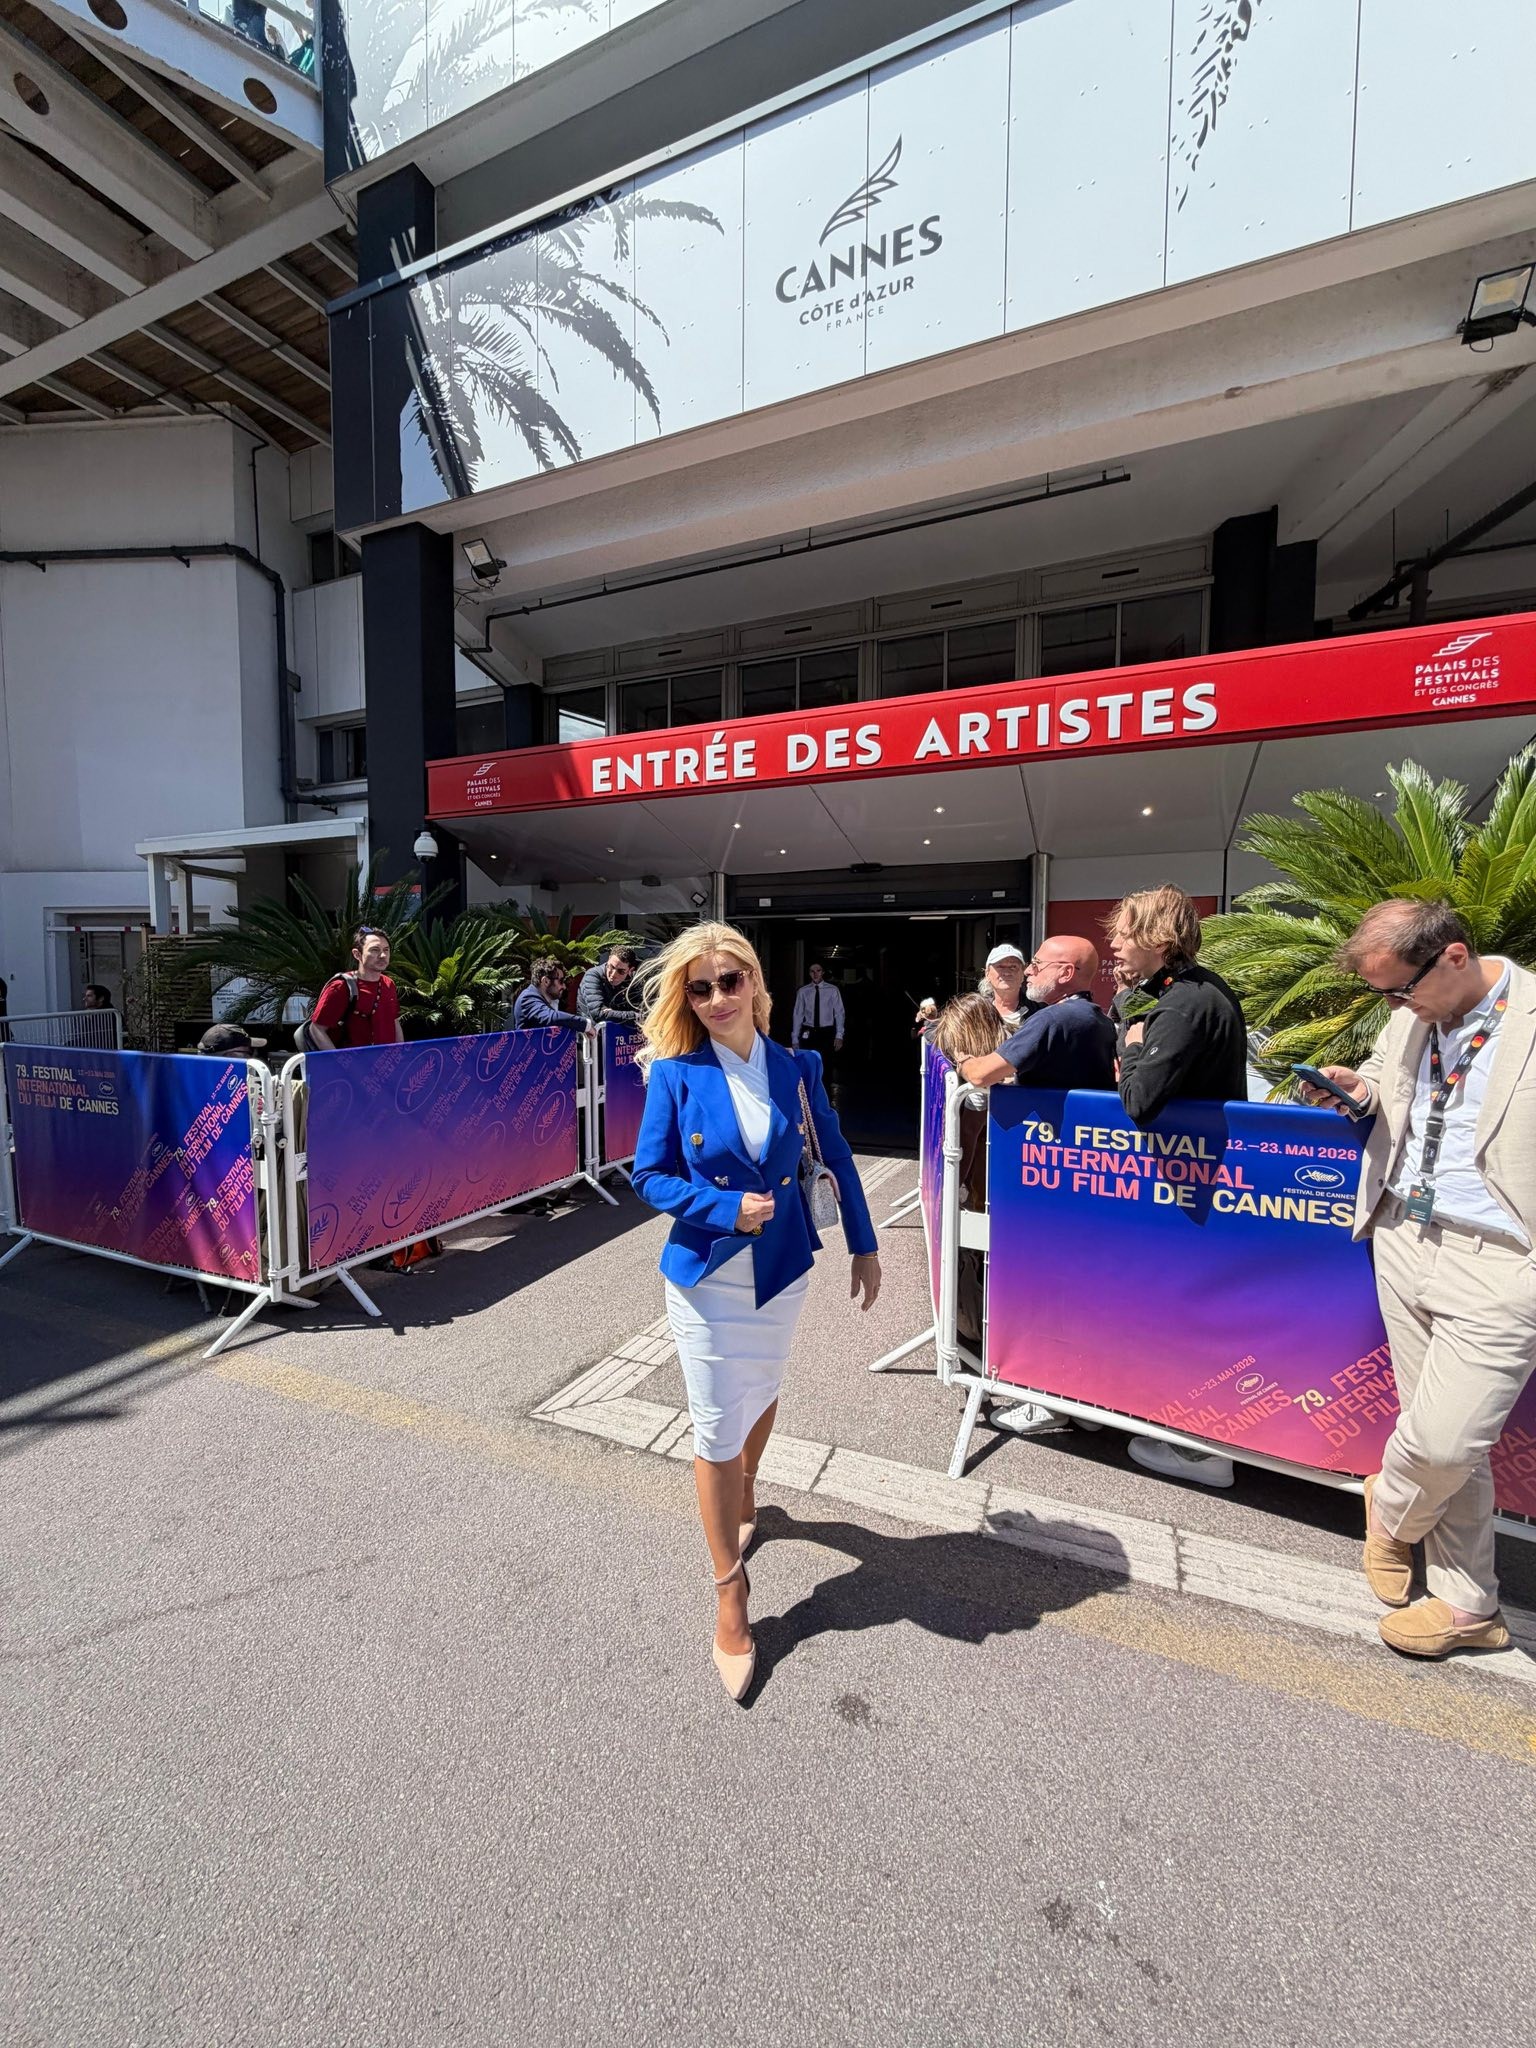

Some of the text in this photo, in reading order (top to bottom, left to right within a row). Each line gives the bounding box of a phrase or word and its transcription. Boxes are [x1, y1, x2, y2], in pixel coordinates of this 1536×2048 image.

[775, 214, 943, 304] CANNES
[799, 276, 914, 325] CÔTE d'AZUR
[826, 305, 884, 332] FRANCE
[1414, 668, 1499, 687] FESTIVALS
[1415, 655, 1499, 674] PALAIS DES
[1414, 680, 1499, 697] ET DES CONGRÈS
[1432, 693, 1476, 706] CANNES
[592, 682, 1218, 794] ENTRÉE DES ARTISTES
[467, 776, 501, 787] PALAIS DES
[467, 784, 501, 794] FESTIVALS
[15, 1064, 77, 1082] 79. FESTIVAL
[16, 1078, 90, 1097] INTERNATIONAL
[19, 1092, 119, 1116] DU FILM DE CANNES
[174, 1147, 186, 1162] 79.
[184, 1102, 215, 1146] FESTIVAL
[179, 1101, 227, 1172] INTERNATIONAL
[184, 1162, 197, 1180] DU
[195, 1138, 214, 1165] FILM
[211, 1123, 223, 1141] DE
[221, 1083, 249, 1124] CANNES
[1022, 1120, 1217, 1160] 79. FESTIVAL
[1285, 1144, 1314, 1157] MAI
[1317, 1146, 1357, 1161] 2026
[145, 1149, 175, 1188] CANNES
[1021, 1143, 1255, 1190] INTERNATIONAL
[206, 1155, 249, 1213] 79. FESTIVAL
[1021, 1166, 1355, 1228] DU FILM DE CANNES
[1283, 1187, 1355, 1200] FESTIVAL DE CANNES
[109, 1205, 122, 1220] 79.
[218, 1215, 230, 1231] DU
[229, 1193, 246, 1216] FILM
[1217, 1367, 1235, 1382] MAI
[1233, 1355, 1257, 1373] 2026
[1211, 1389, 1293, 1440] CANNES
[1292, 1389, 1333, 1414] 79.
[1325, 1418, 1361, 1449] DU
